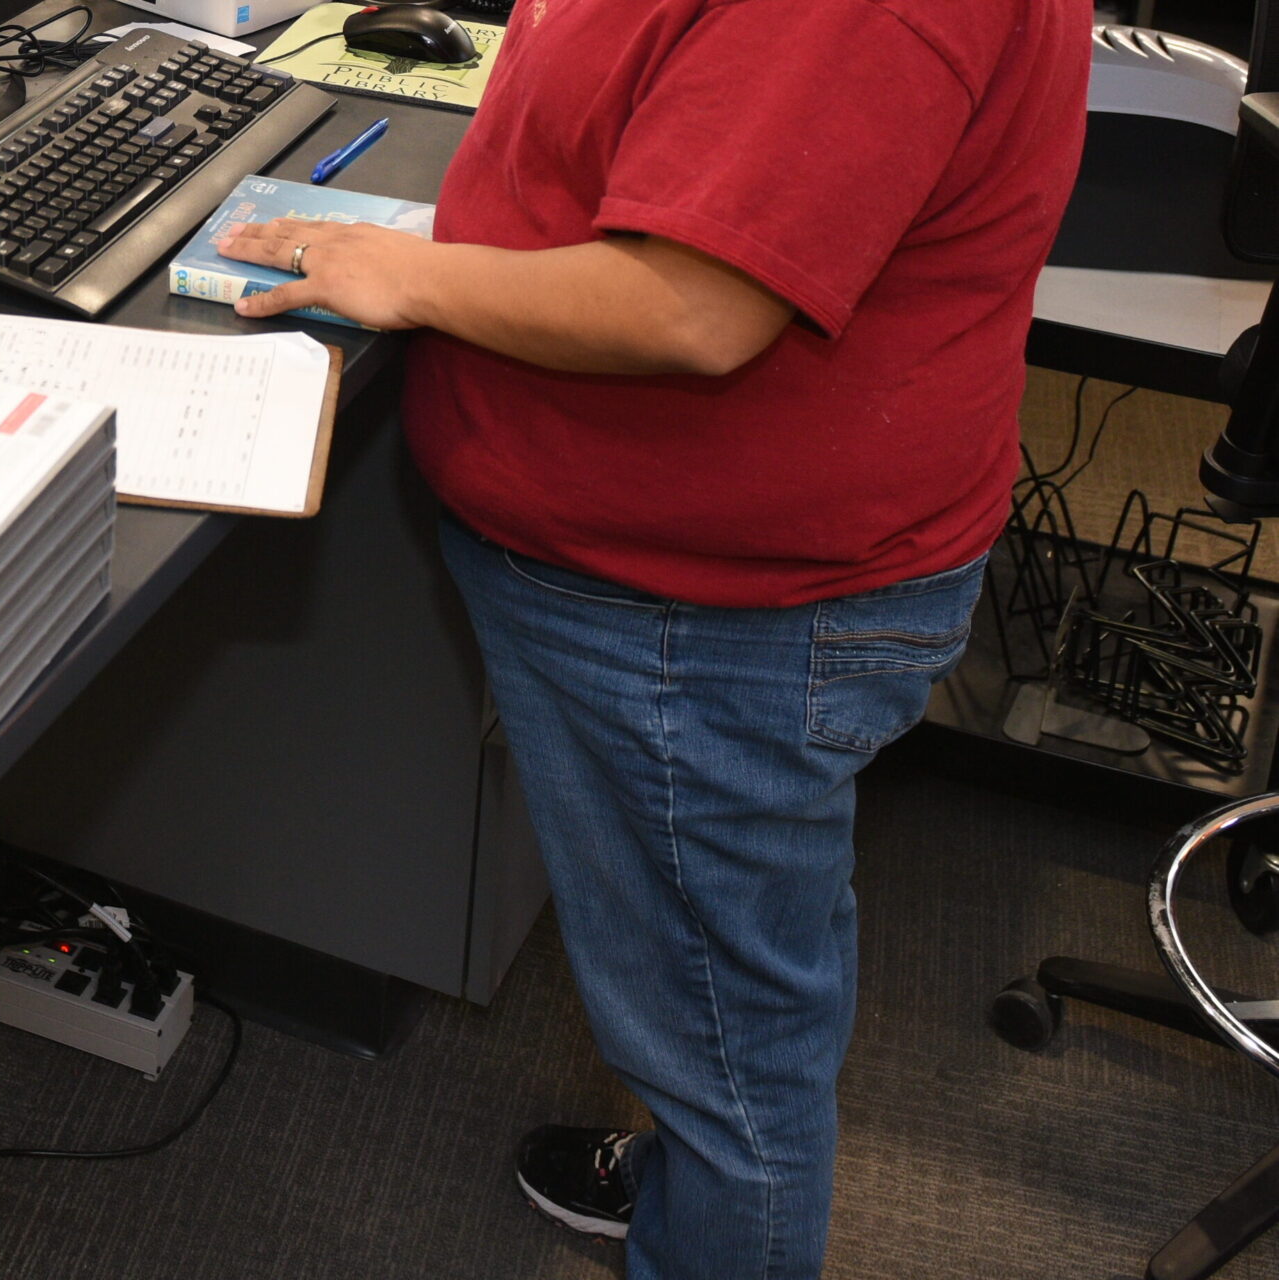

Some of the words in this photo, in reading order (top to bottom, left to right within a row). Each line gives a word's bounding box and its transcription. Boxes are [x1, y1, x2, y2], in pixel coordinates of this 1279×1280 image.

[124, 34, 151, 52] lenovo
[322, 73, 449, 100] LIBRARY
[333, 66, 449, 92] PUBLIC
